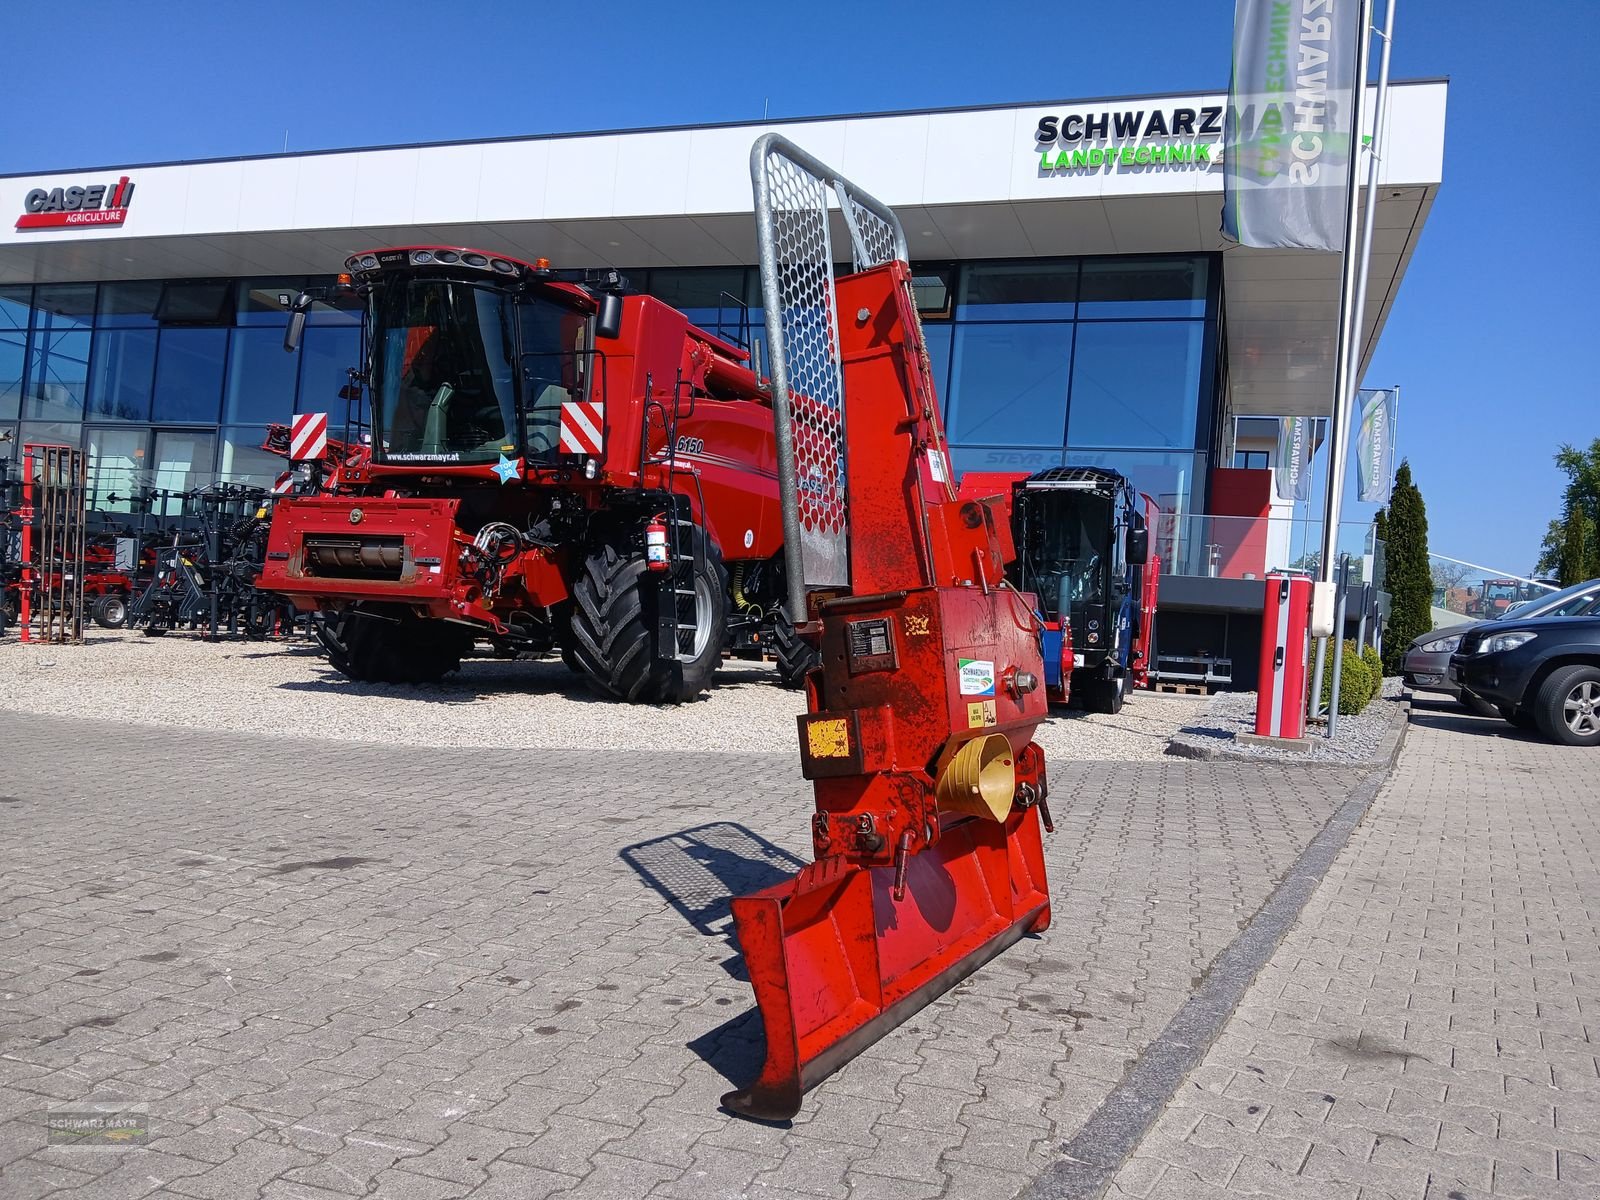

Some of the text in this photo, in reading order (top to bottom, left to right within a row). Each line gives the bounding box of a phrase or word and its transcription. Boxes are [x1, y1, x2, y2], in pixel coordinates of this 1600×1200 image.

[1041, 143, 1212, 170] LANDTECHNIK
[25, 185, 106, 212] CASE
[66, 211, 121, 223] AGRICULTURE
[677, 435, 704, 454] 6150
[387, 453, 460, 462] www.schwarzmayr.at
[984, 452, 1041, 464] STEYR
